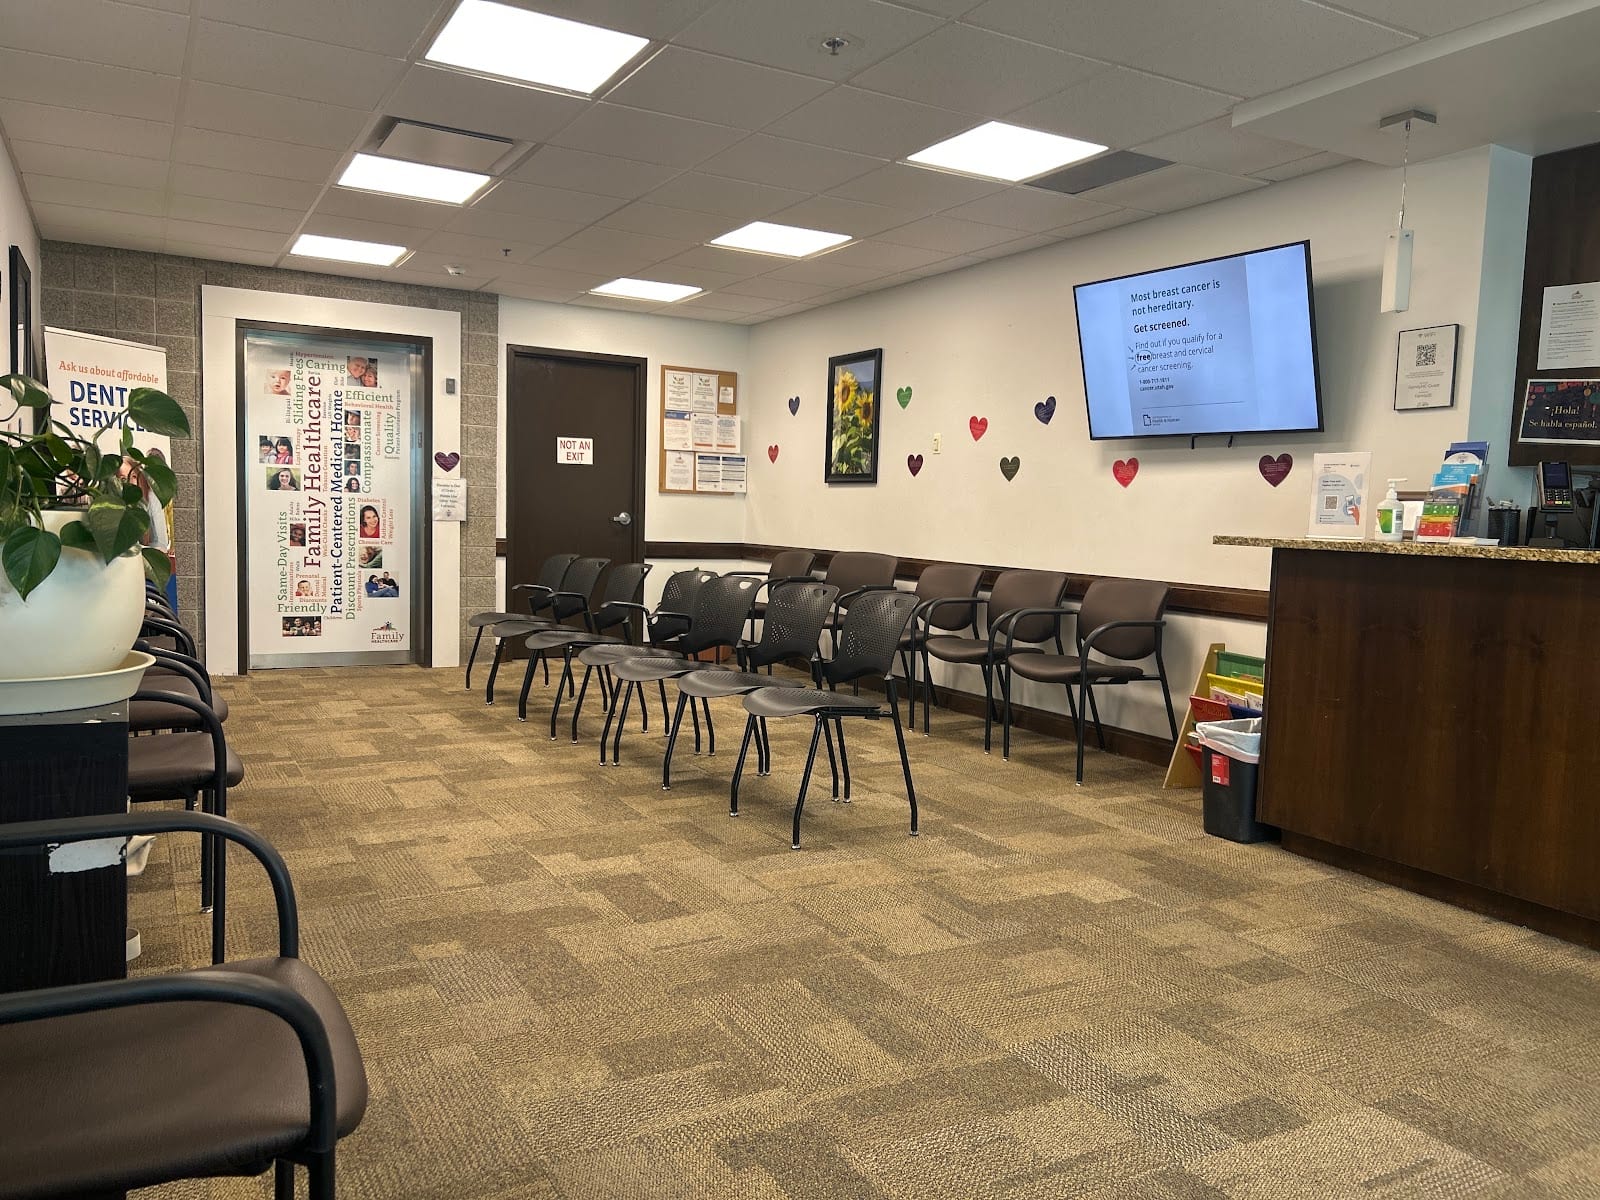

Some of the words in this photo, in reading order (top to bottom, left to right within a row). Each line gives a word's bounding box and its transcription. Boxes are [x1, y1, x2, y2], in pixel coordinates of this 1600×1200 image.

[1130, 292, 1151, 303] Most
[1152, 287, 1180, 299] breast
[1181, 282, 1211, 294] cancer
[1212, 280, 1221, 289] is
[1132, 307, 1147, 316] not
[1147, 299, 1194, 314] hereditary.
[1133, 324, 1150, 334] Get
[1149, 317, 1190, 332] screened.
[1135, 341, 1149, 350] Find
[1150, 340, 1161, 348] out
[1162, 338, 1167, 347] if
[1167, 338, 1180, 348] you
[1181, 334, 1205, 345] qualify
[1206, 332, 1217, 341] for
[1136, 352, 1151, 361] free
[1152, 350, 1173, 360] breast
[1174, 348, 1187, 357] and
[1188, 345, 1214, 356] cervical
[59, 360, 76, 372] Ask
[78, 365, 88, 374] us
[89, 366, 116, 378] about
[117, 369, 159, 384] affordable
[293, 358, 304, 381] Fees
[305, 359, 346, 374] Caring
[1137, 364, 1158, 373] cancer
[1160, 361, 1193, 371] screening.
[69, 380, 128, 408] DENT
[293, 384, 306, 424] Sliding
[345, 391, 394, 403] Efficient
[330, 390, 342, 433] Home
[1550, 405, 1580, 417] ¡Hola!
[303, 375, 321, 492] Healthcare
[384, 413, 396, 454] Quality
[1529, 419, 1538, 427] Se
[1540, 419, 1563, 428] habla
[1564, 420, 1598, 430] español.
[362, 410, 374, 494] Compassionate
[560, 440, 577, 450] NOT
[578, 440, 591, 450] AN
[566, 451, 585, 461] EXIT
[330, 437, 342, 493] Medical
[277, 511, 288, 543] Visits
[303, 495, 326, 568] Family
[346, 497, 357, 569] Prescriptions
[330, 496, 342, 614] Patient-Centered
[277, 545, 290, 601] Same-Day
[346, 572, 356, 620] Discount
[278, 603, 327, 614] Friendly
[371, 632, 404, 642] Family
